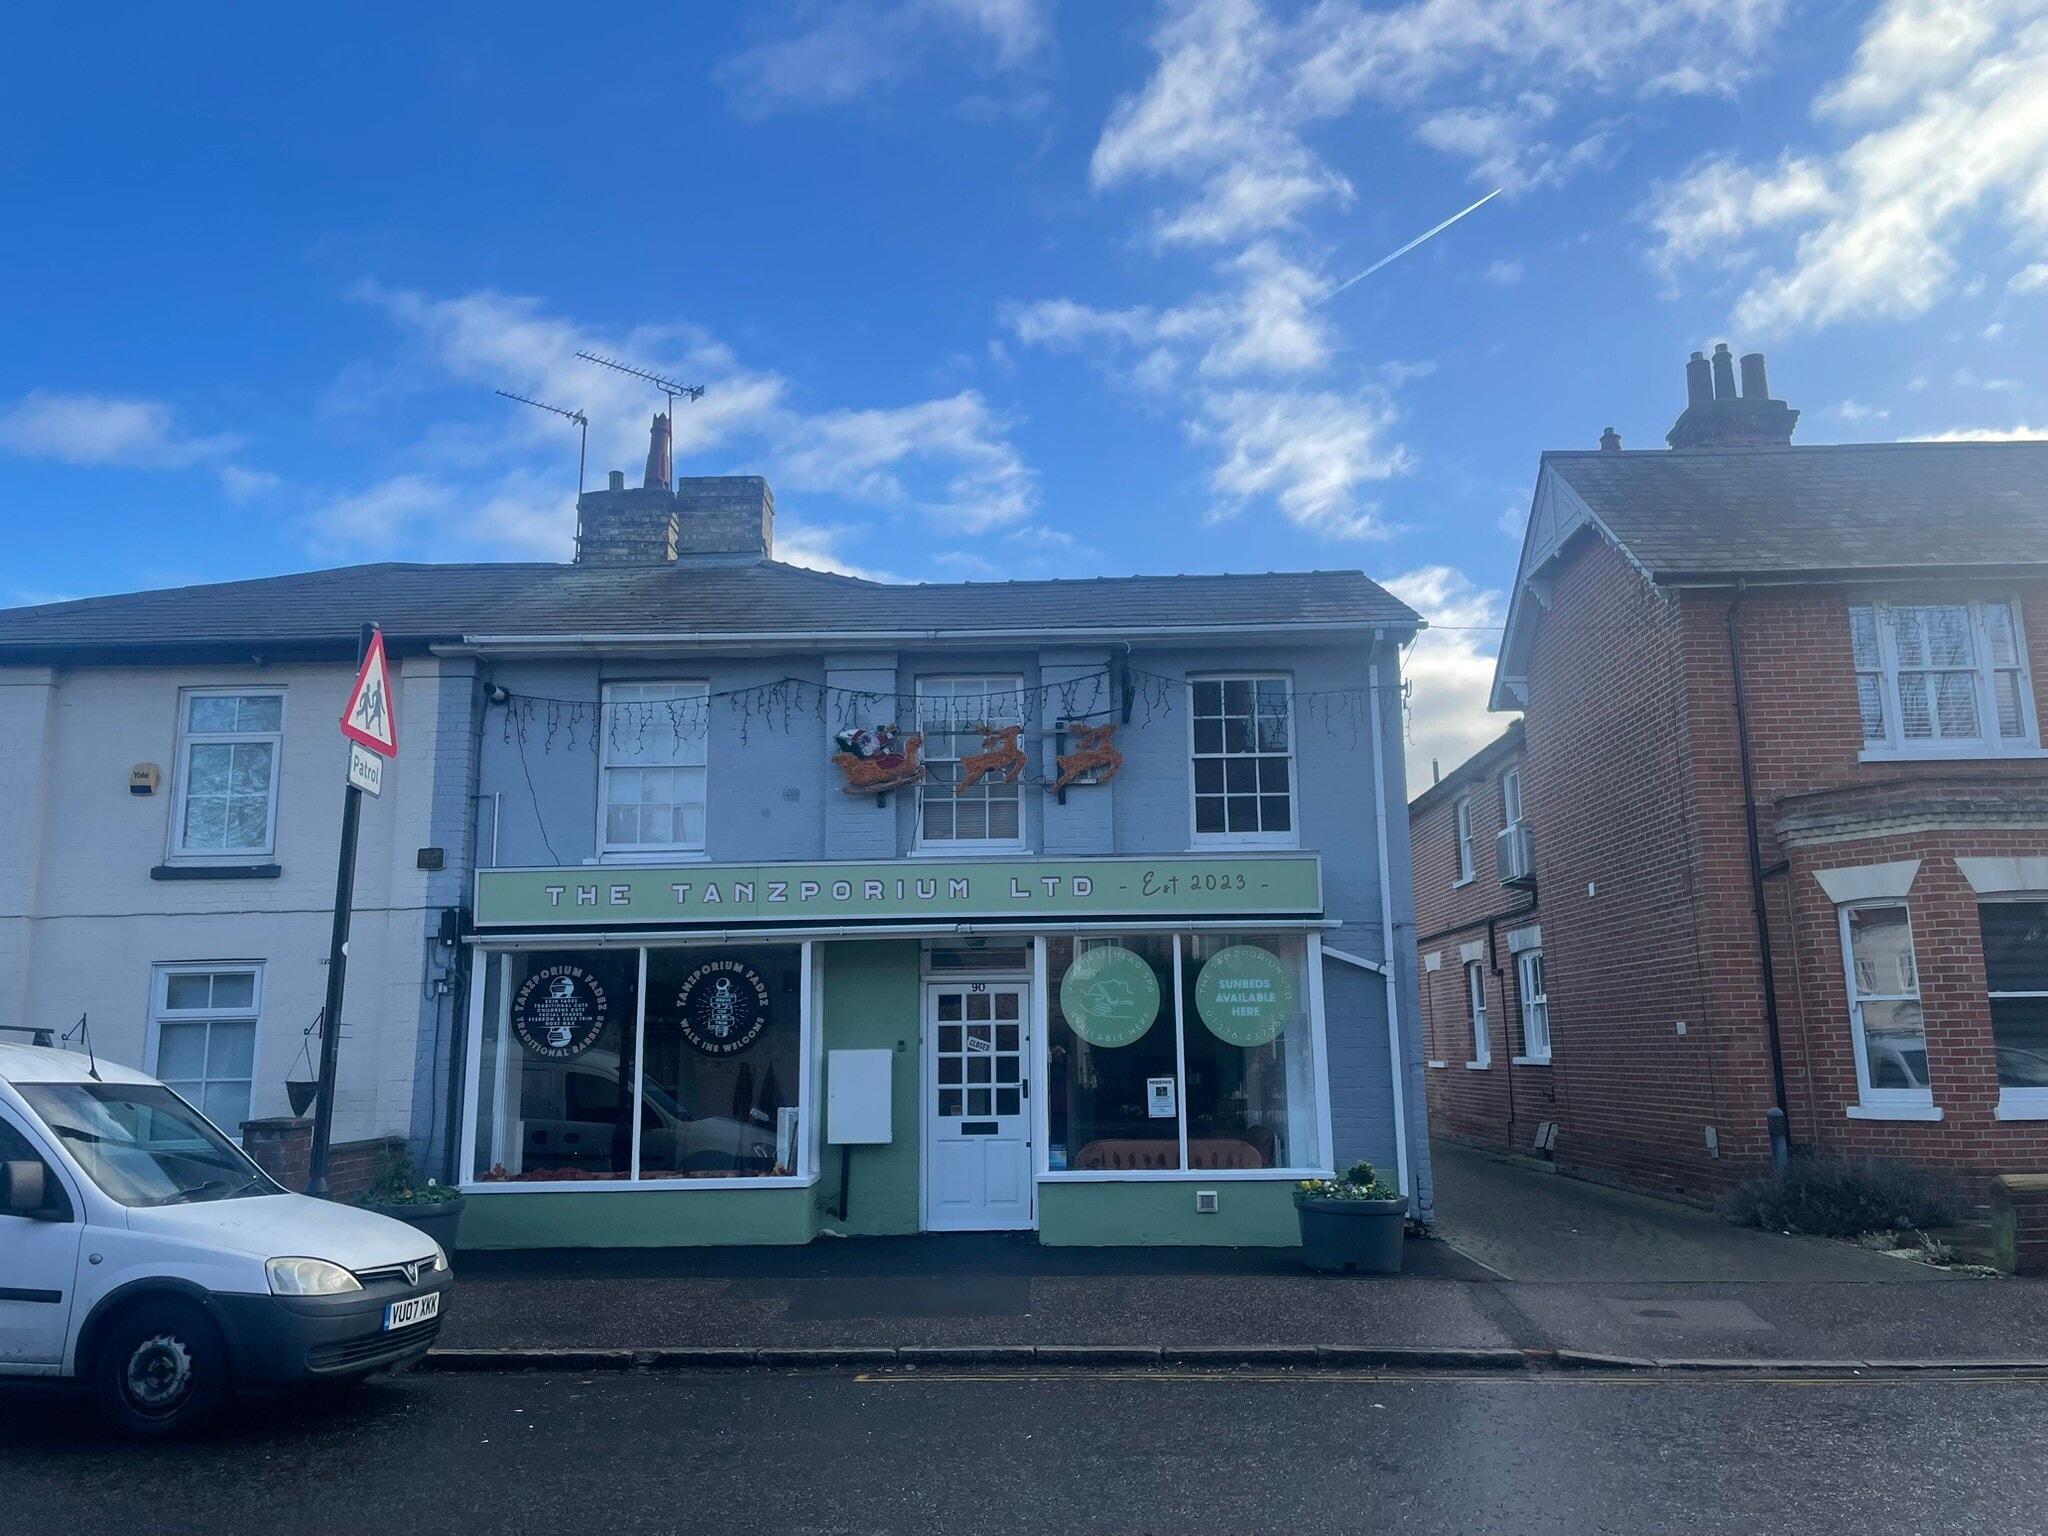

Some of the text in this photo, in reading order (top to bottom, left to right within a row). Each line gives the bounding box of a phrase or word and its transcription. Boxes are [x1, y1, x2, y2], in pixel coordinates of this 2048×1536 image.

[133, 771, 150, 779] Yale
[353, 754, 379, 785] Patrol
[545, 884, 631, 906] THE
[671, 878, 970, 904] TANZPORIUM
[1010, 876, 1094, 899] LTD
[1142, 871, 1179, 896] Est
[1190, 874, 1246, 891] 2023
[676, 961, 769, 1007] TANZPORIUM FADEZ
[1113, 950, 1142, 969] HEAD
[1142, 971, 1155, 993] SPA
[1200, 971, 1212, 994] THE
[1280, 976, 1292, 1000] LTD
[1218, 979, 1271, 989] SUNBEDS
[514, 965, 608, 1012] TANZPORIUM FADEZ
[971, 983, 986, 992] 90
[1215, 992, 1276, 1003] AVAILABLE
[1128, 1012, 1151, 1035] HERE
[1206, 1009, 1238, 1040] 01376
[1231, 1006, 1260, 1017] HERE
[516, 1015, 605, 1058] TRADITIONAL BARBERS
[680, 1017, 765, 1053] WALK INS WELCOME
[969, 1039, 990, 1051] CLOSED
[393, 1300, 419, 1325] VU07
